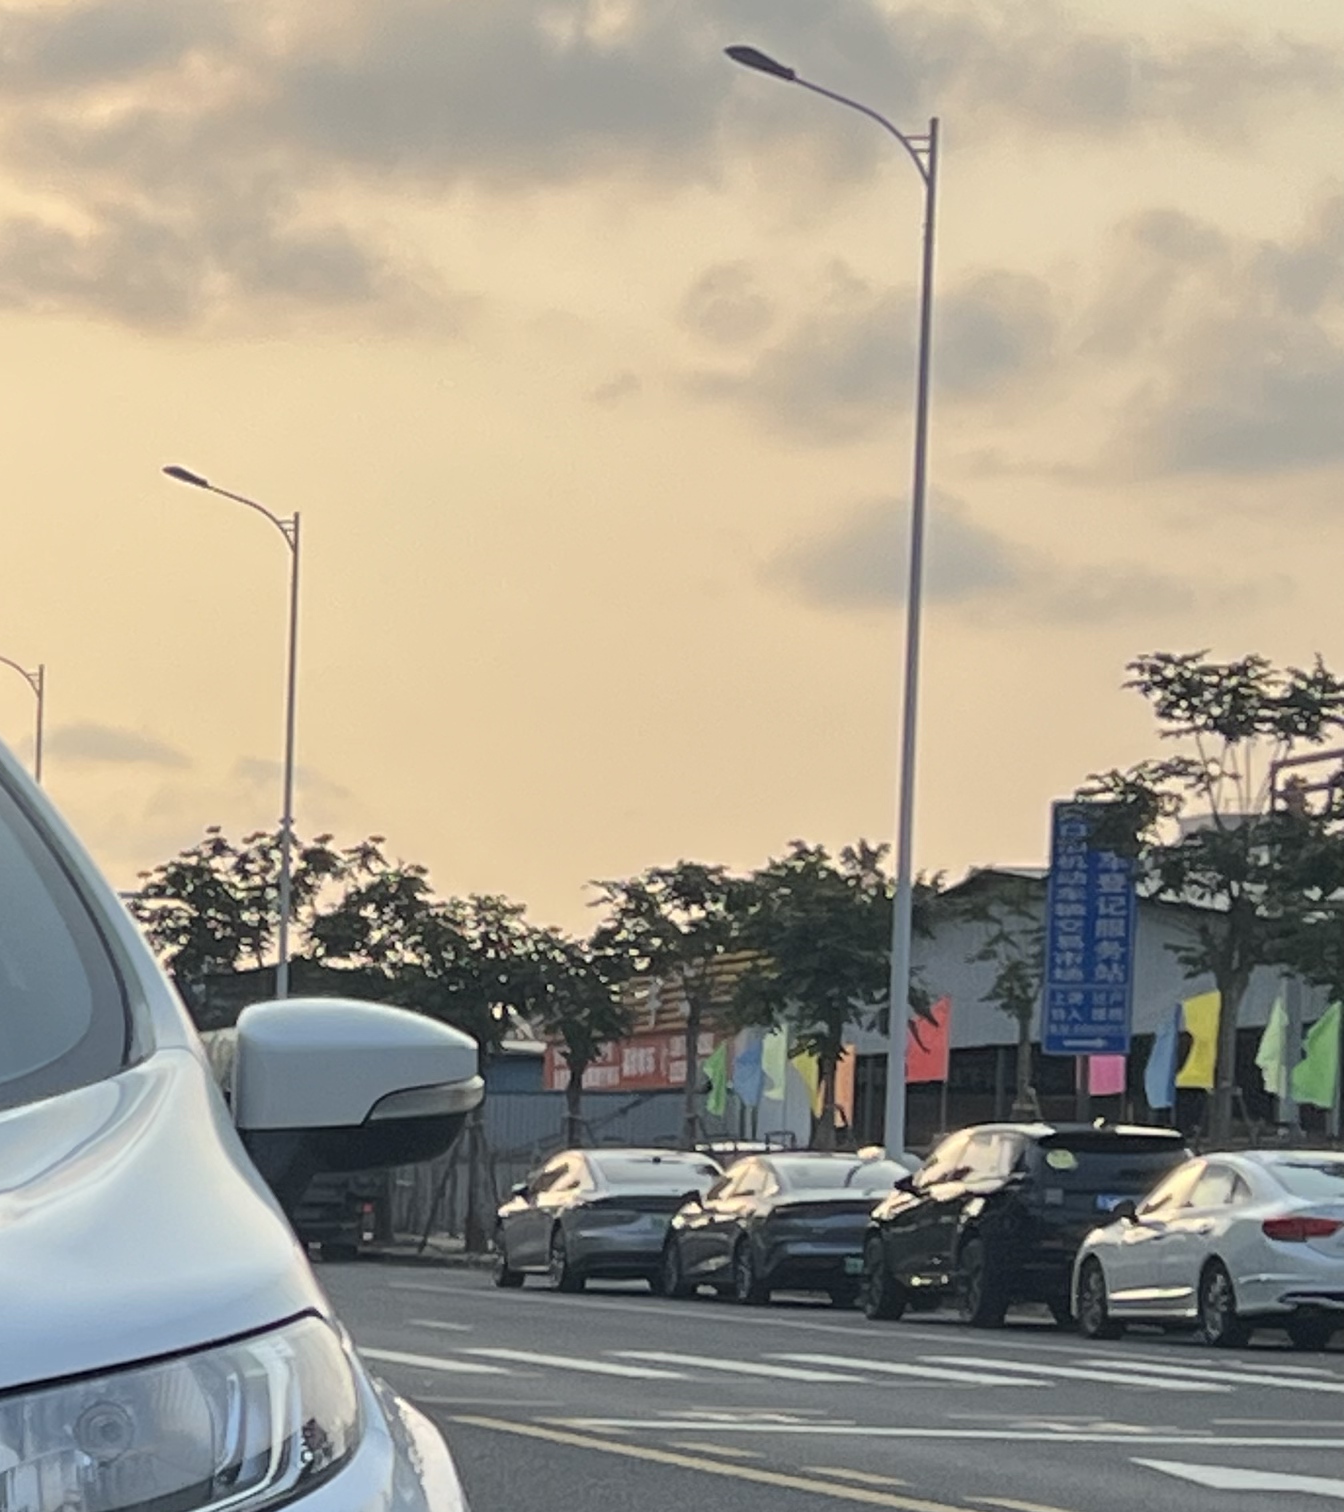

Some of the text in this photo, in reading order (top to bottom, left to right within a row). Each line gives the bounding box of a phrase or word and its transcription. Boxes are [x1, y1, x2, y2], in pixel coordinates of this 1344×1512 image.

[1054, 805, 1088, 982] 口机动车辆交易市场
[1094, 852, 1129, 982] 车登记服务站
